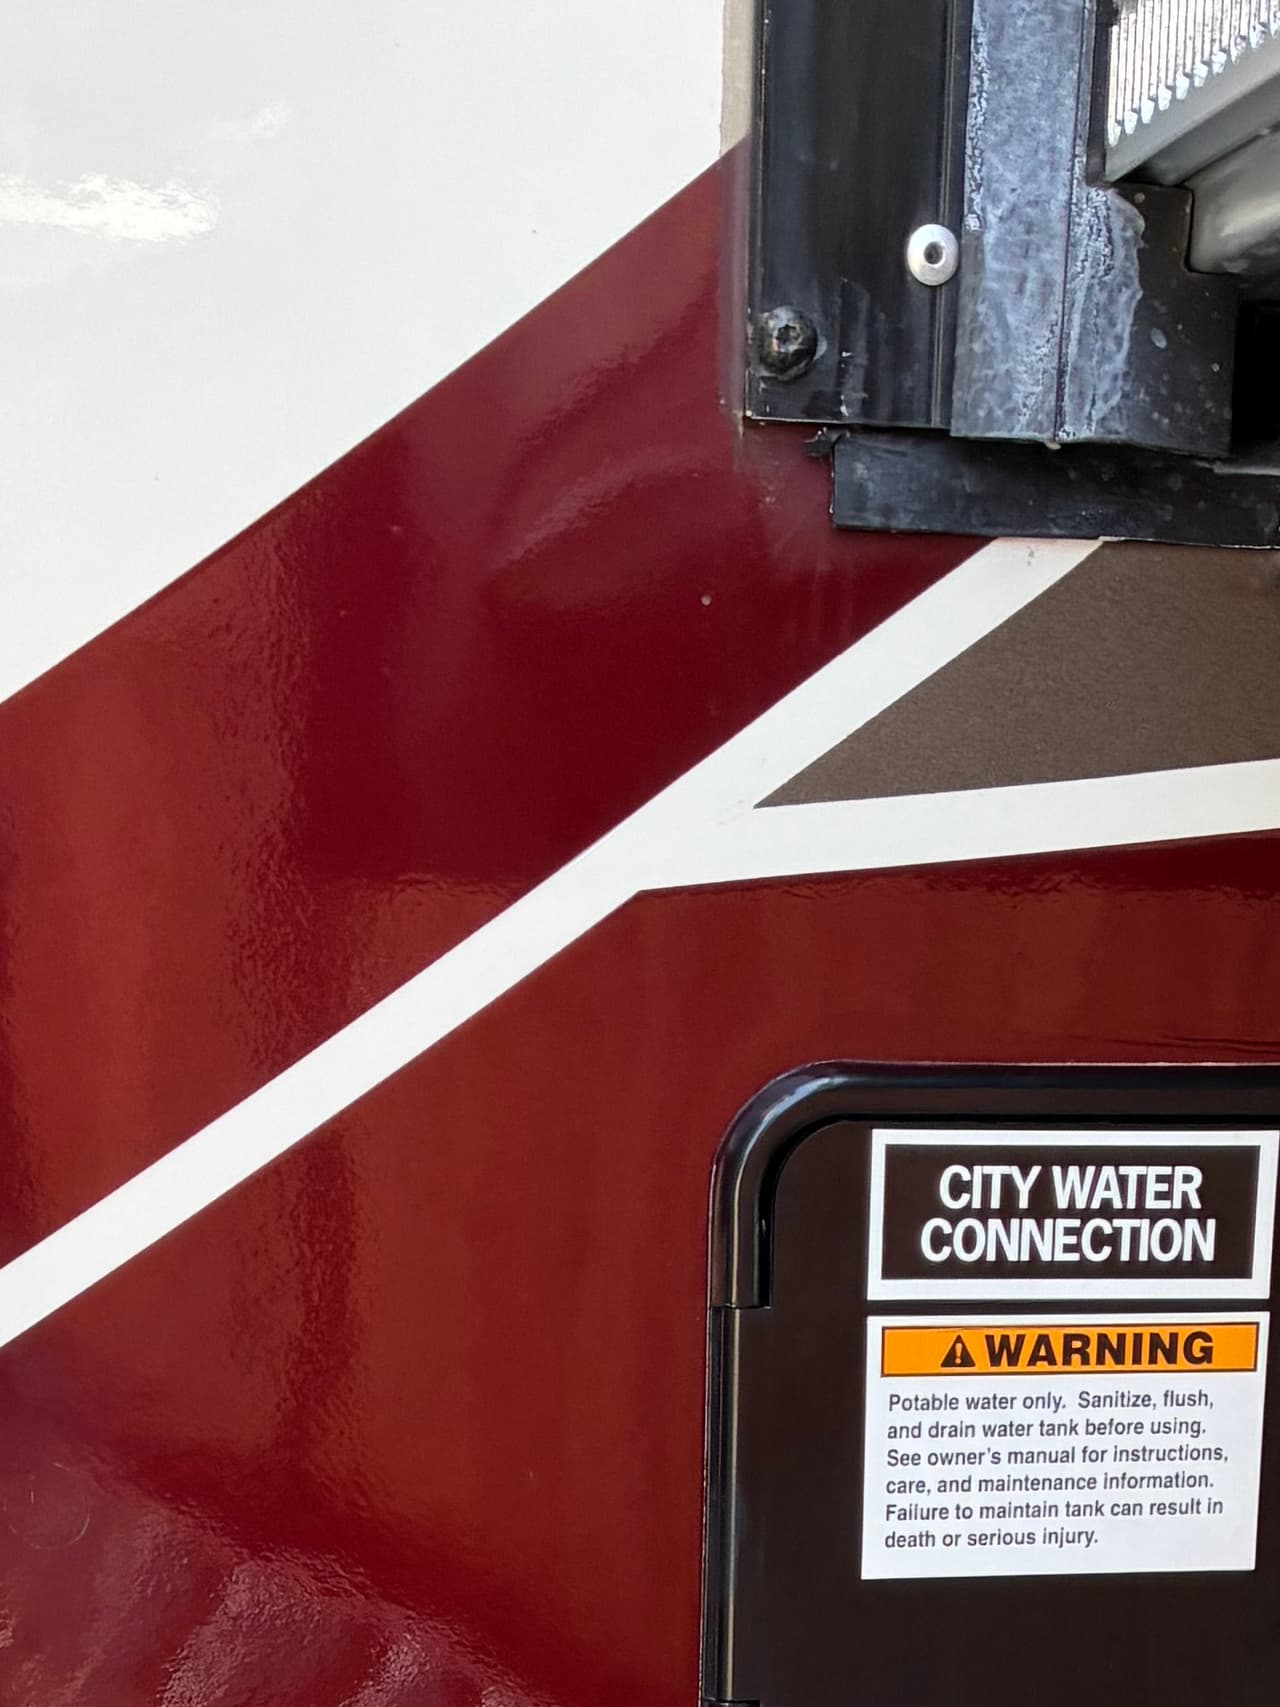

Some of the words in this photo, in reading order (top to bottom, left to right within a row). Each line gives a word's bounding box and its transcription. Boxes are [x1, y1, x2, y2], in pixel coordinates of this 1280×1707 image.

[939, 1165, 1042, 1209] CITY
[1052, 1165, 1202, 1209] WATER
[921, 1218, 1216, 1262] CONNECTION
[985, 1331, 1213, 1367] WARNING
[889, 1393, 959, 1412] Potable
[965, 1393, 1017, 1410] water
[1022, 1392, 1066, 1414] only.
[1078, 1390, 1156, 1410] Sanitize,
[1163, 1389, 1213, 1409] flush,
[887, 1421, 922, 1439] and
[928, 1420, 975, 1438] drain
[982, 1420, 1034, 1437] water
[1039, 1418, 1079, 1437] tank
[1085, 1418, 1144, 1435] before
[1150, 1417, 1206, 1438] using.
[887, 1449, 921, 1467] See
[927, 1447, 1001, 1466] owner's
[1008, 1446, 1075, 1464] manual
[1082, 1446, 1108, 1463] for
[1113, 1444, 1228, 1463] instructions,
[886, 1479, 931, 1495] care,
[937, 1475, 972, 1493] and
[978, 1474, 1097, 1492] maintenance
[1103, 1471, 1214, 1490] information.
[886, 1503, 949, 1521] Failure
[955, 1504, 973, 1520] to
[979, 1500, 1058, 1519] maintain
[1065, 1500, 1105, 1517] tank
[1110, 1502, 1143, 1516] can
[1149, 1497, 1201, 1515] result
[1207, 1497, 1223, 1514] in
[885, 1530, 935, 1548] death
[942, 1534, 962, 1547] or
[967, 1528, 1036, 1546] serious
[1043, 1527, 1098, 1548] injury.
